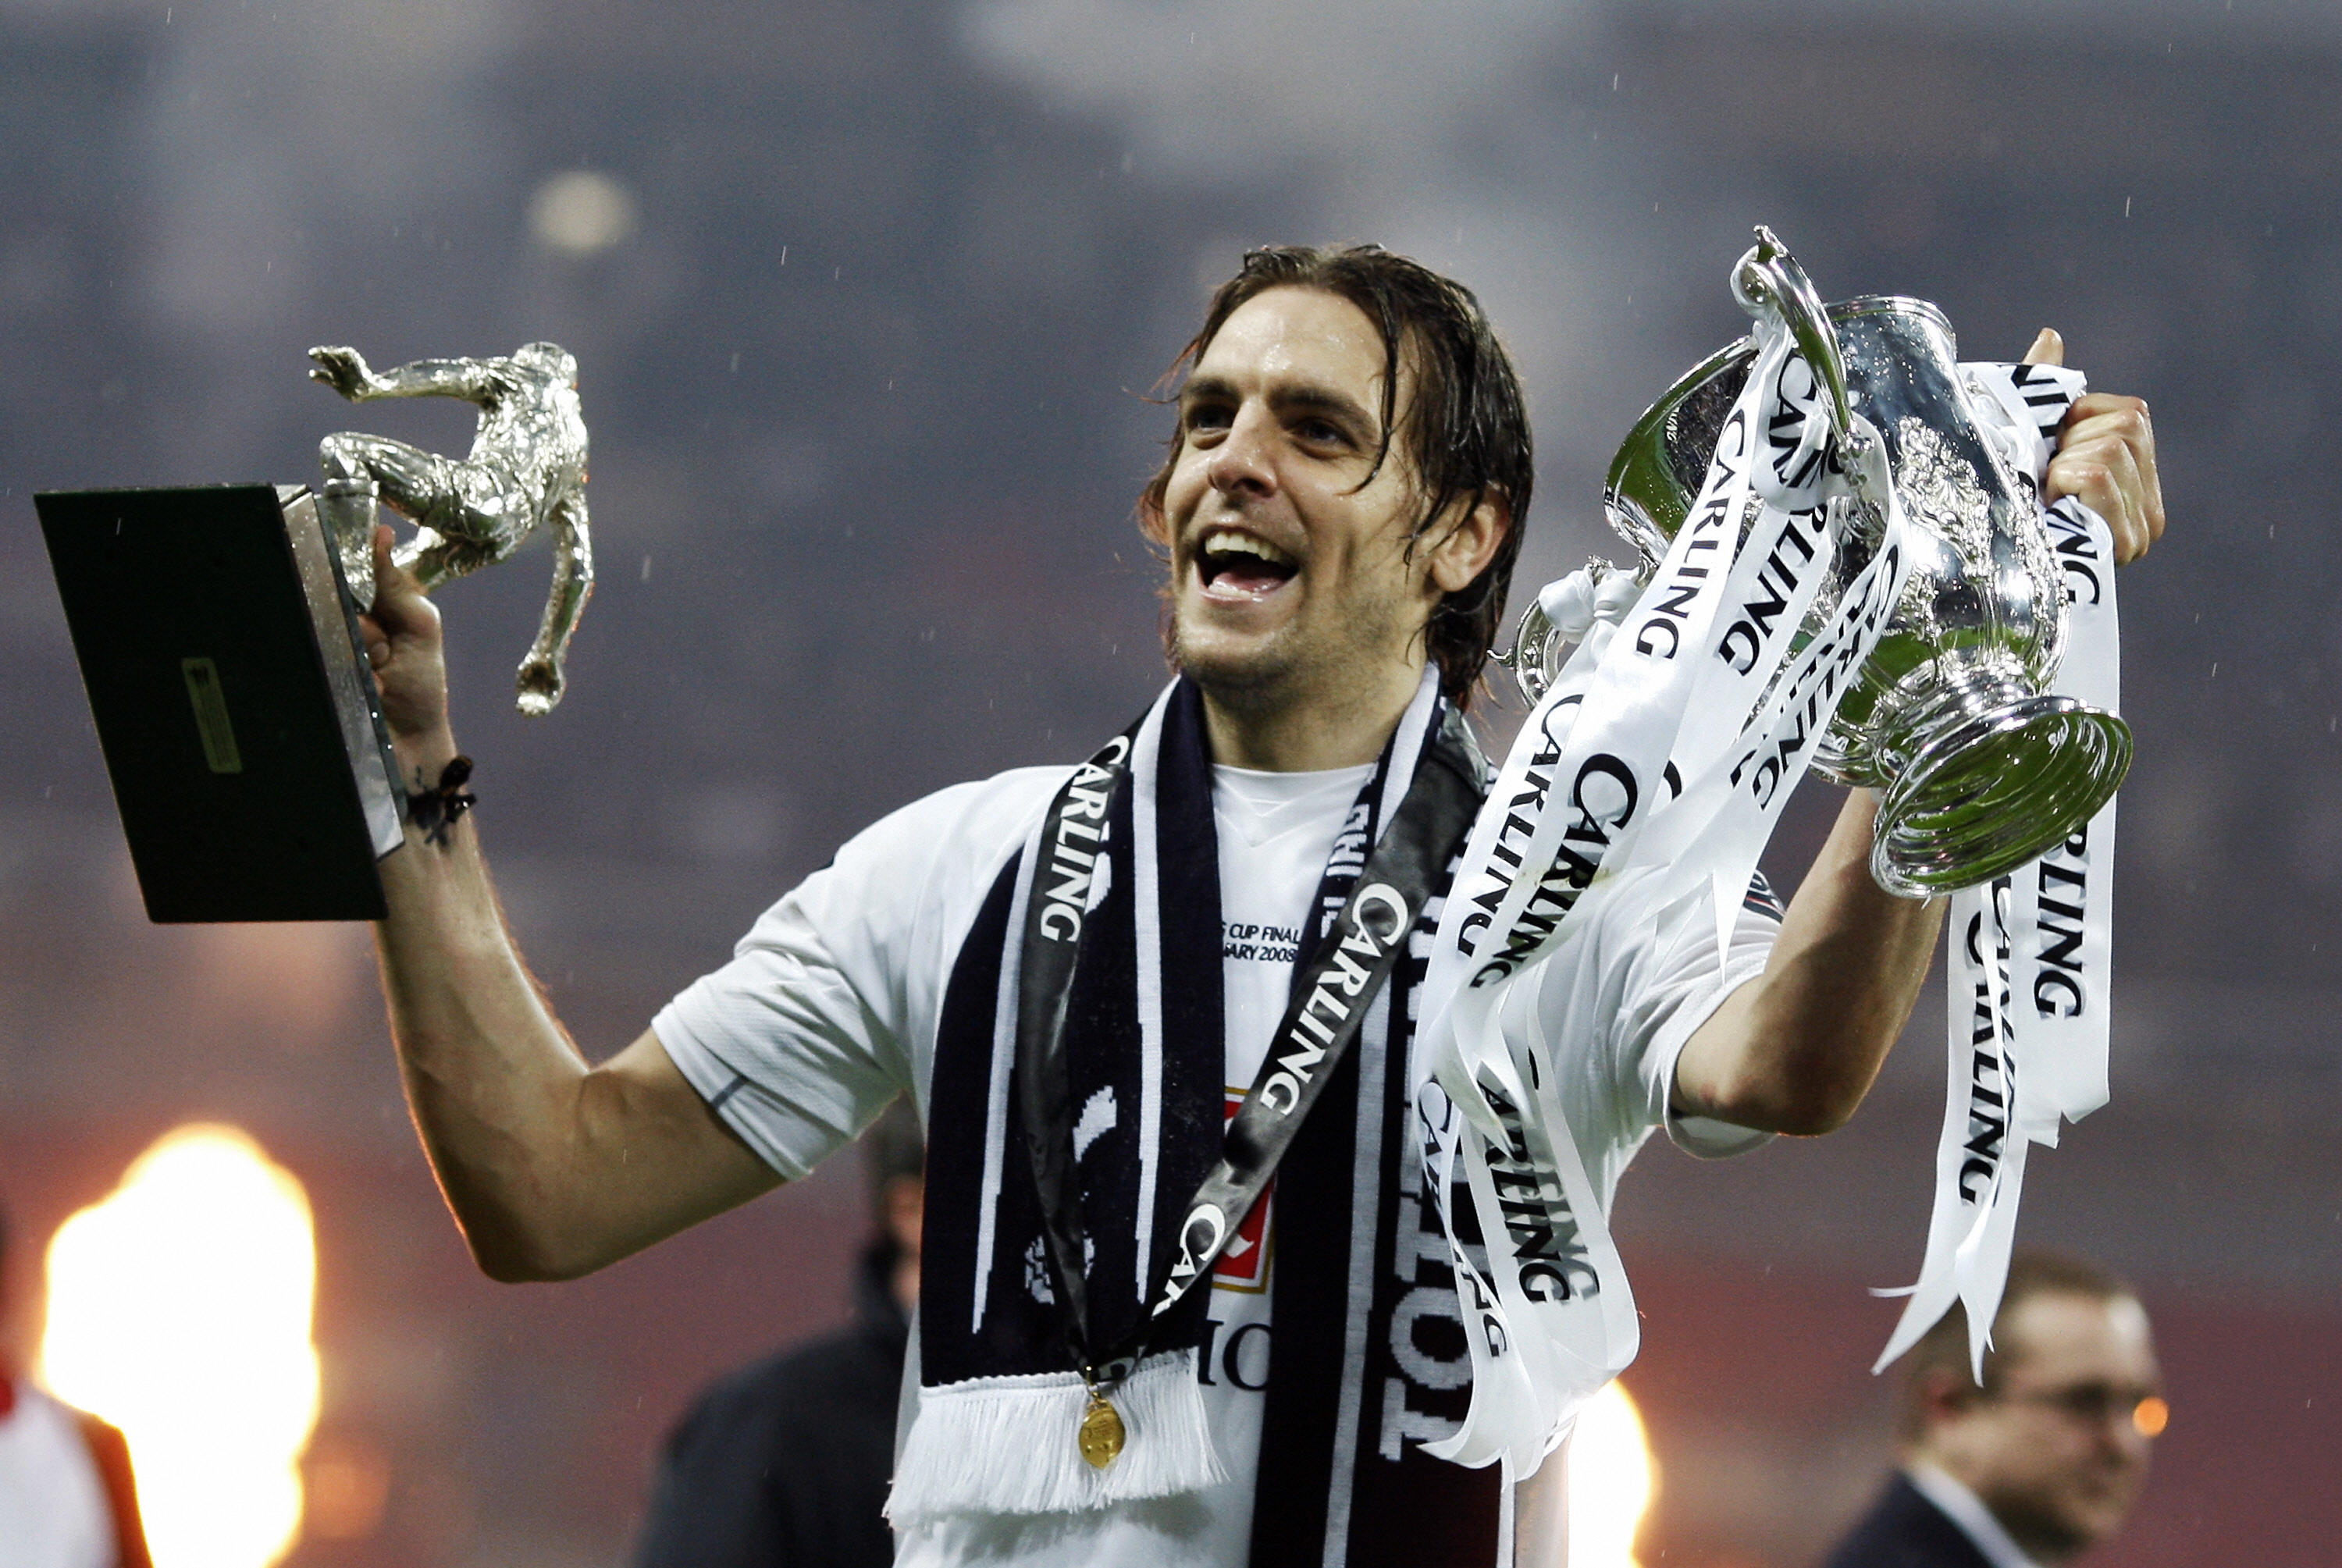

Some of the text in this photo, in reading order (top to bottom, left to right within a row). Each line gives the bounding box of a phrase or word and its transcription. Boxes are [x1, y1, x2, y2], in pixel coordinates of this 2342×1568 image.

[1636, 409, 1746, 660] CARLING
[1041, 735, 1130, 942] CARLING
[1229, 923, 1259, 940] CUP
[1262, 926, 1300, 944] FINAL
[1469, 753, 1638, 989] CARLING
[1258, 946, 1299, 962] 2008
[1259, 883, 1408, 1116] CARLING
